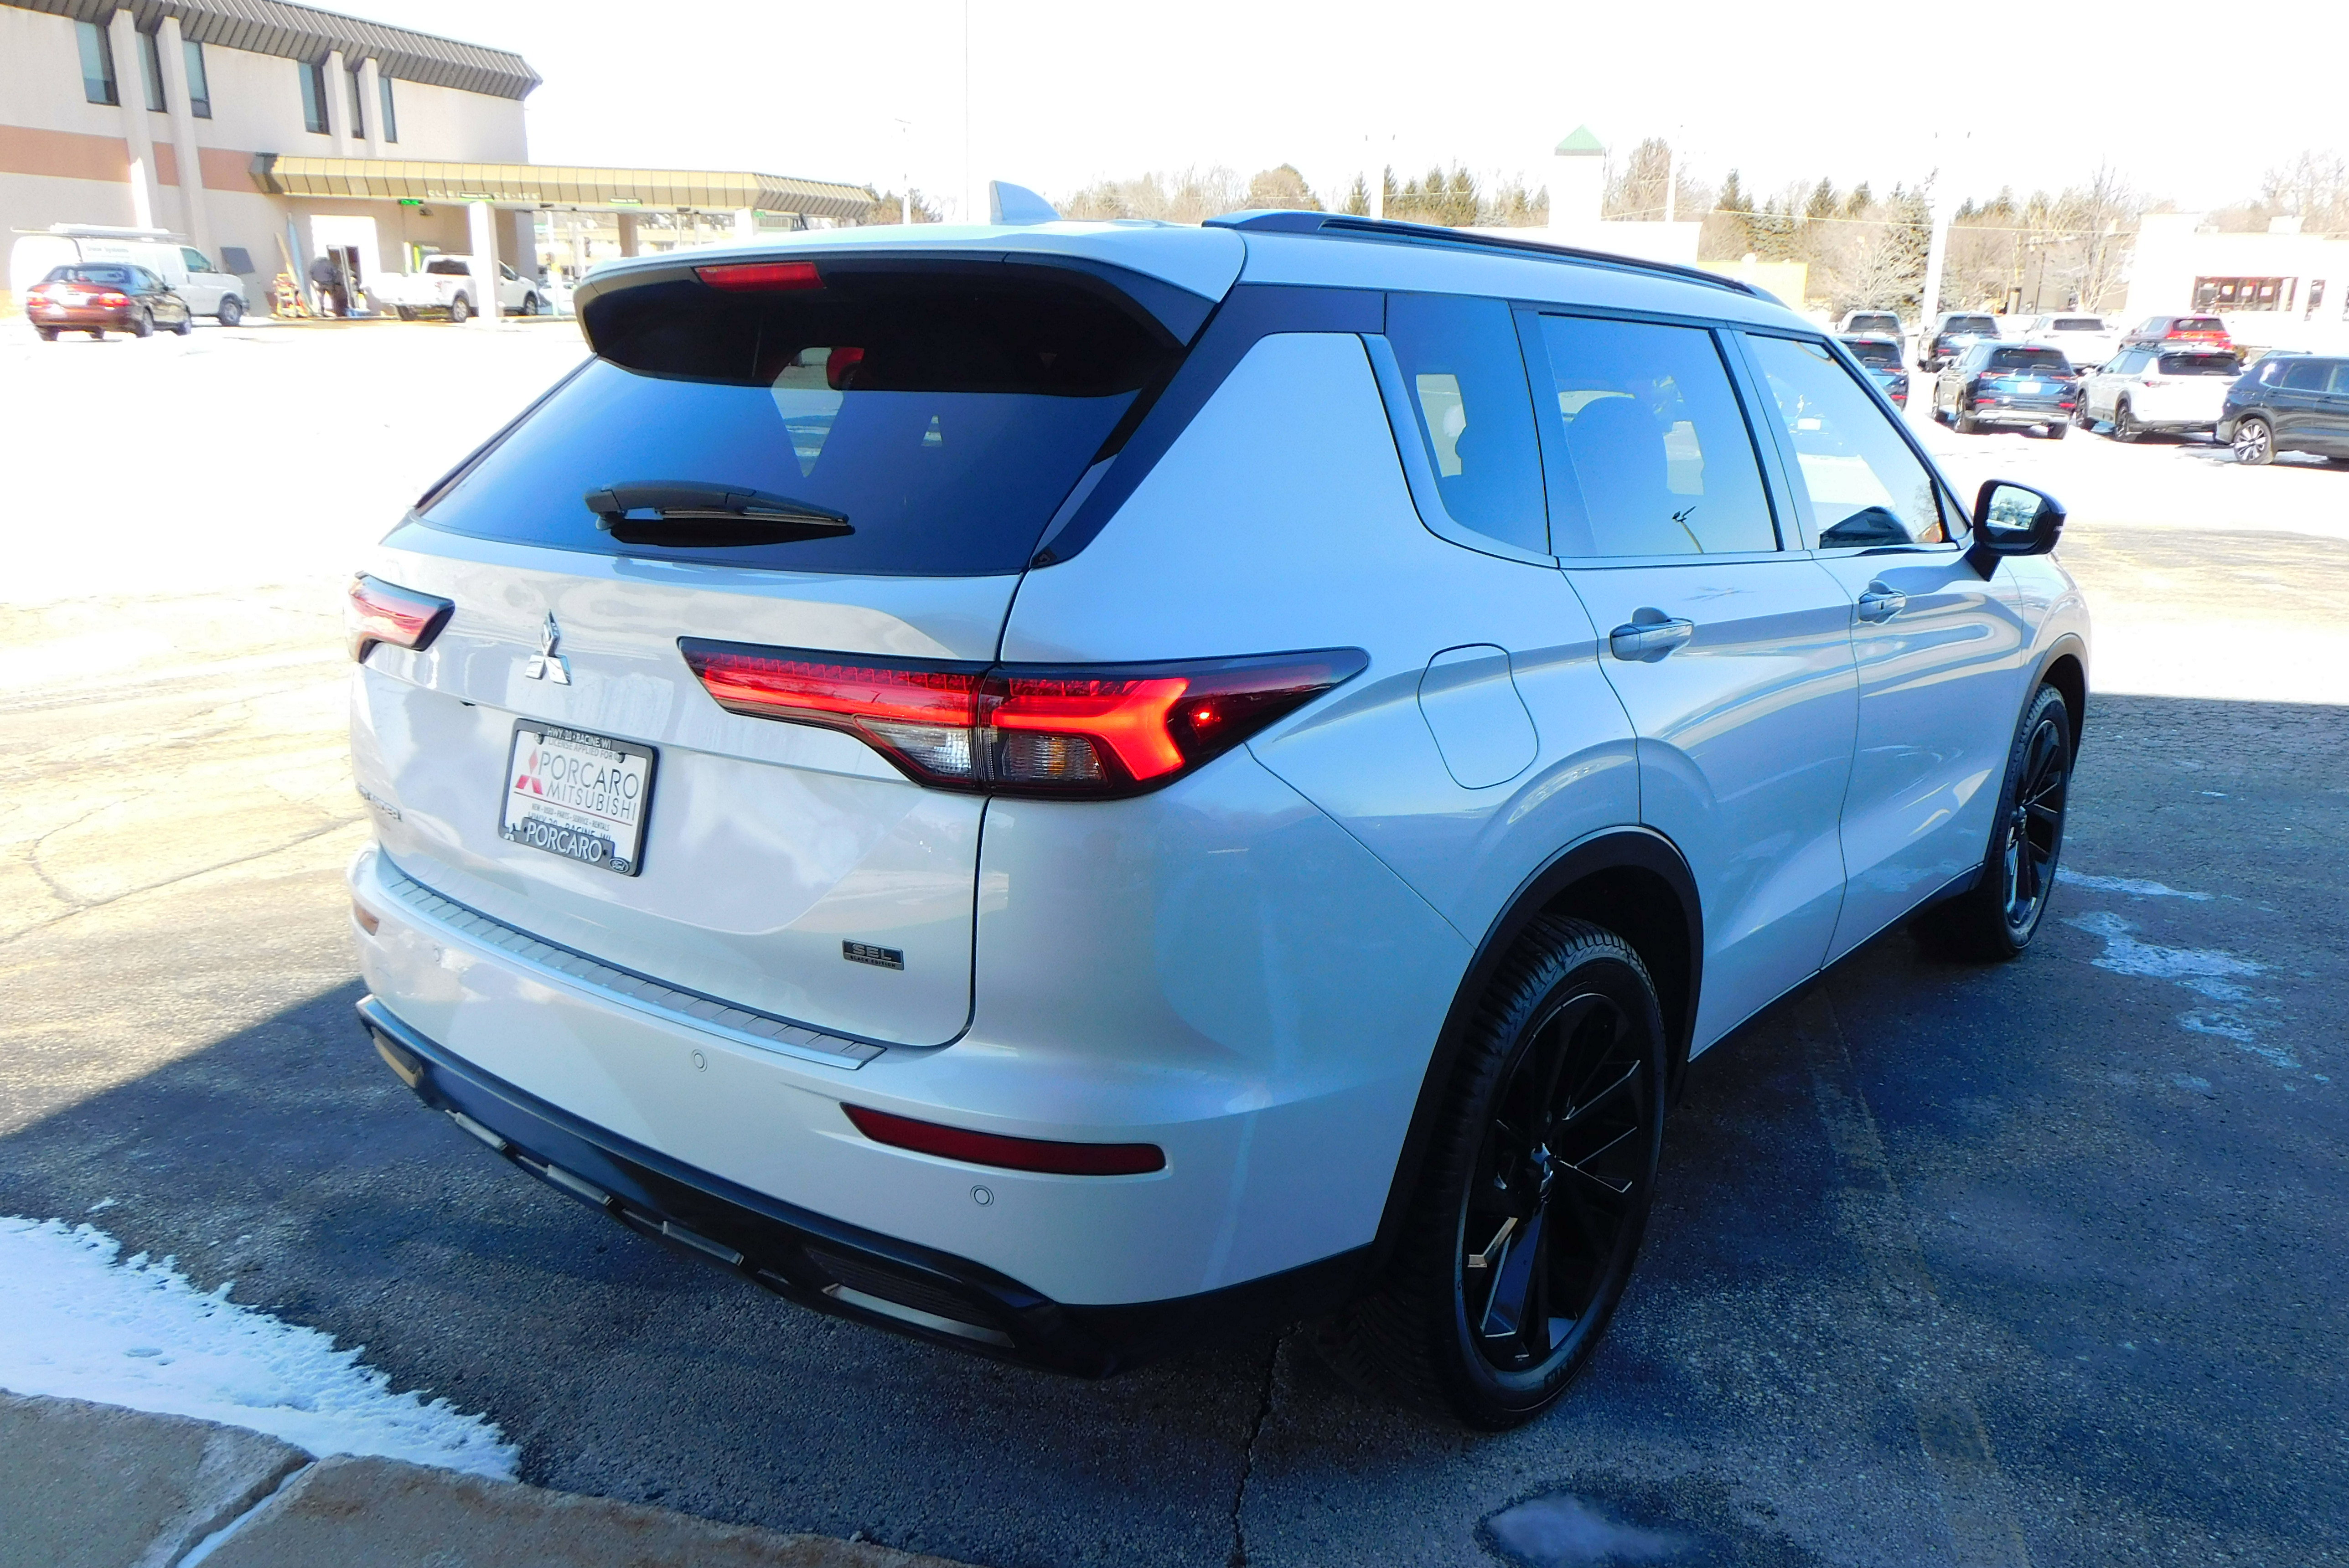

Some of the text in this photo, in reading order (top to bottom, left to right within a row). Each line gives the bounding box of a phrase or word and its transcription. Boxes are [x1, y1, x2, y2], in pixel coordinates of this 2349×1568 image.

[548, 738, 613, 760] LICENSE APPLIED FOR
[601, 738, 611, 750] WI
[538, 750, 638, 799] PORCARO
[546, 780, 636, 821] MITSUBISHI
[557, 810, 570, 820] PARTS
[573, 814, 589, 825] SERVICE
[592, 820, 610, 831] RENTALS
[526, 821, 603, 862] PORCARO
[852, 944, 892, 961] SEL
